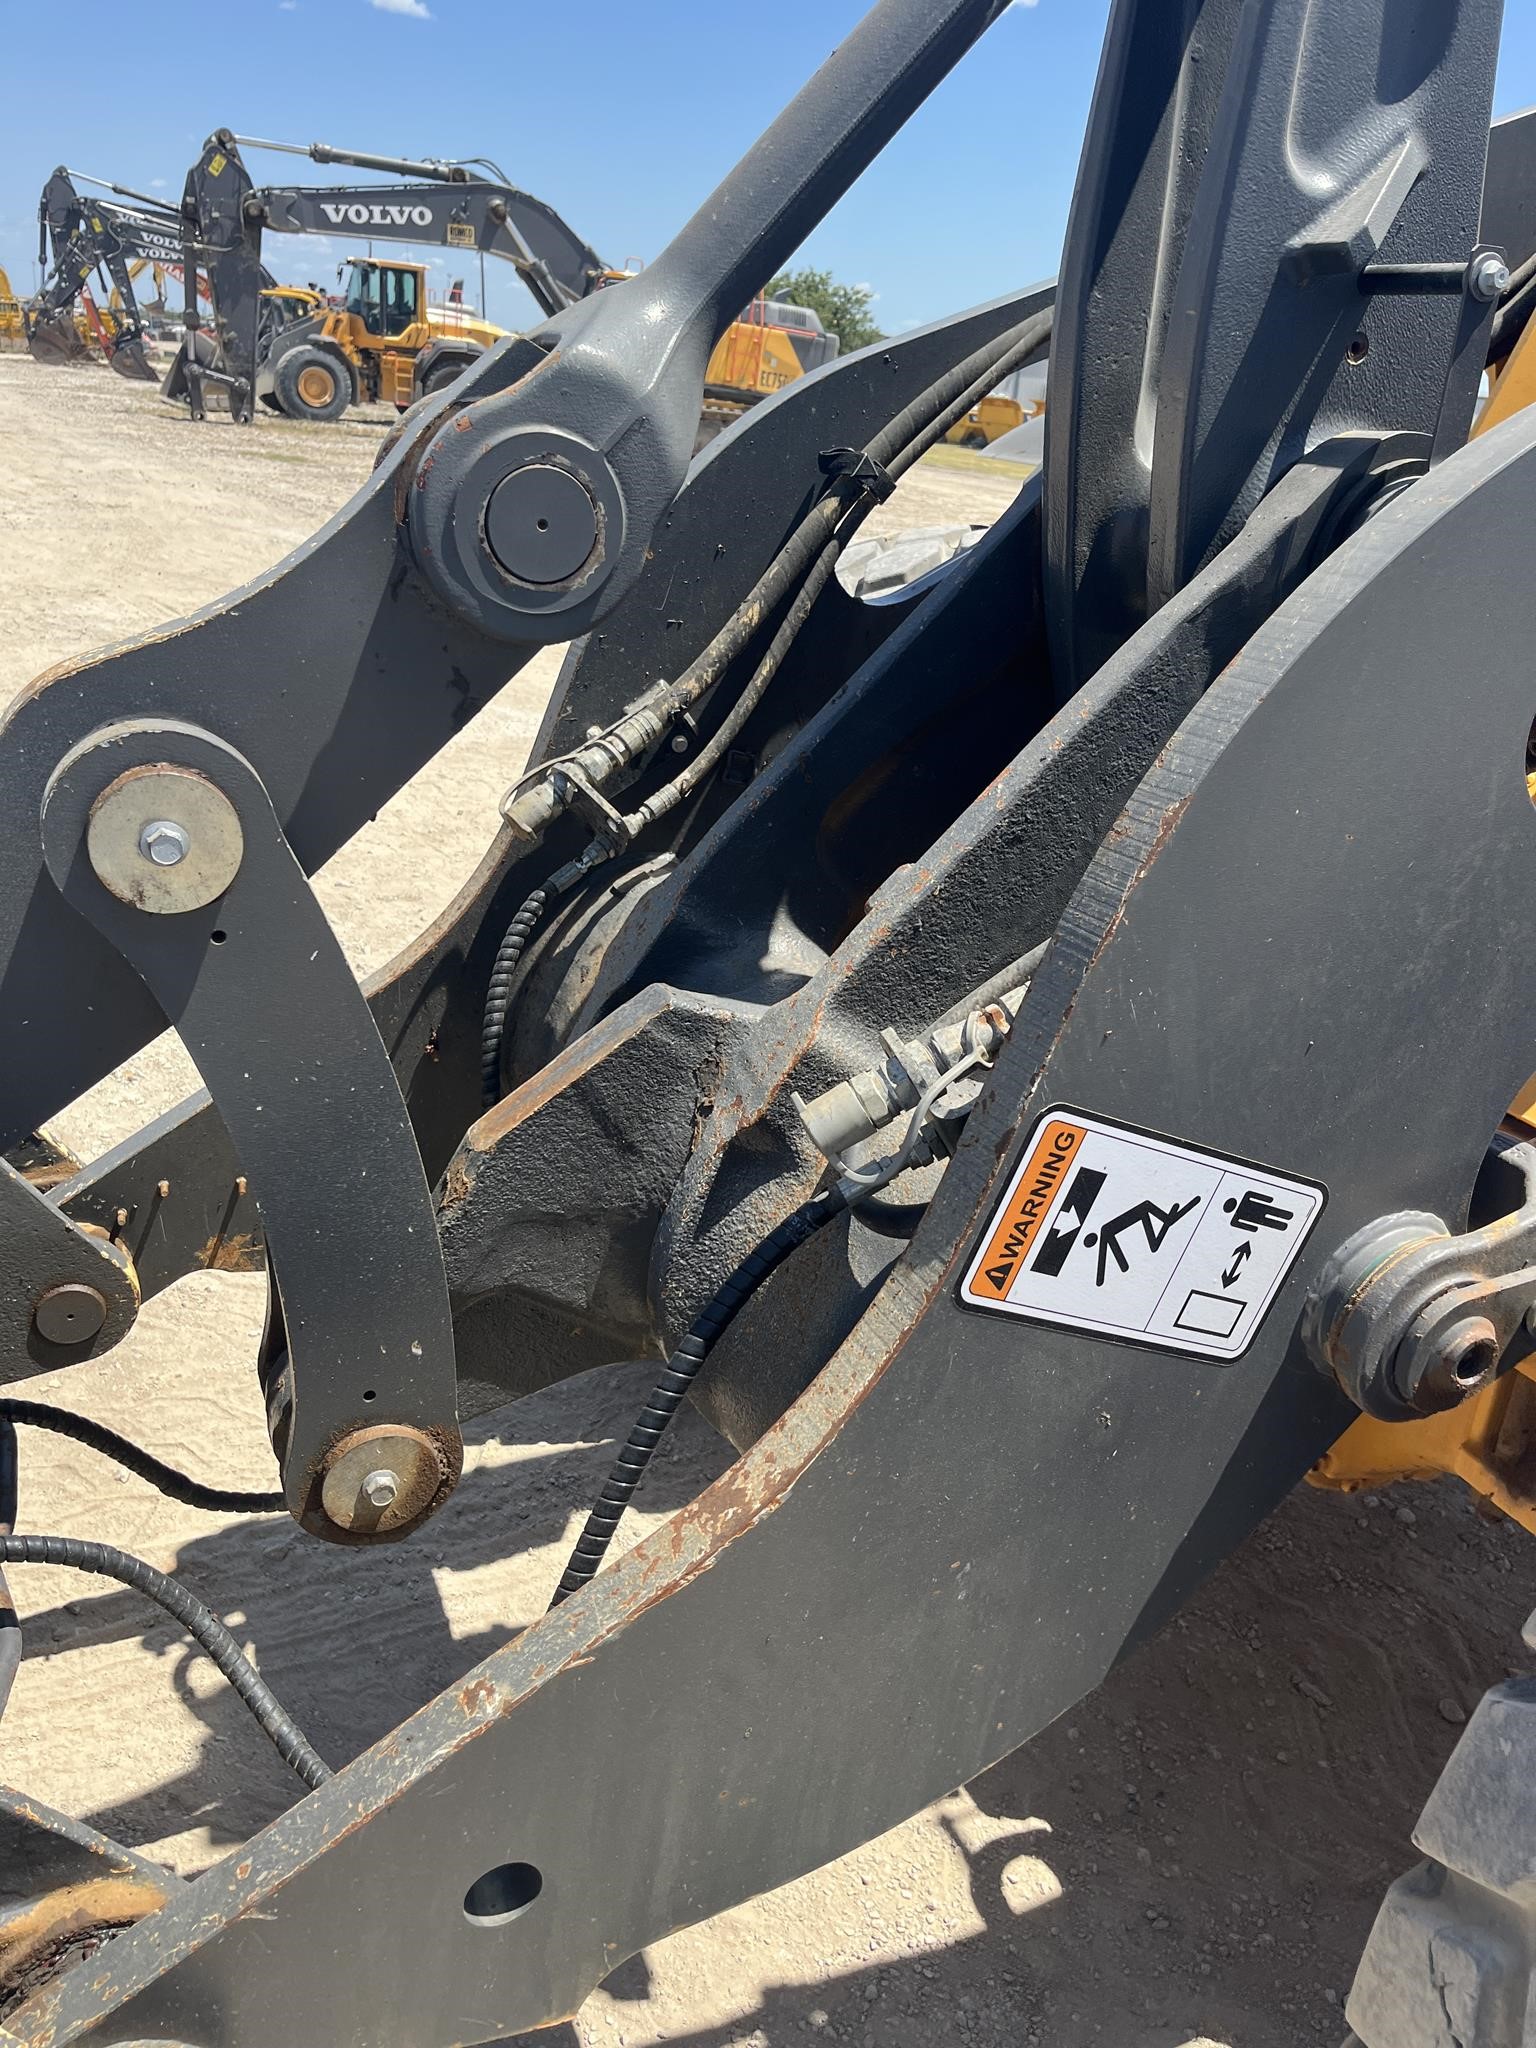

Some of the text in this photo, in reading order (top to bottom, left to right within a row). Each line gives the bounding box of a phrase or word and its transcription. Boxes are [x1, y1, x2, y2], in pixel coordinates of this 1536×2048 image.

[320, 203, 432, 227] VOLVO
[140, 231, 184, 250] VOLV
[136, 247, 184, 260] VOLV
[998, 1131, 1076, 1259] WARNING
